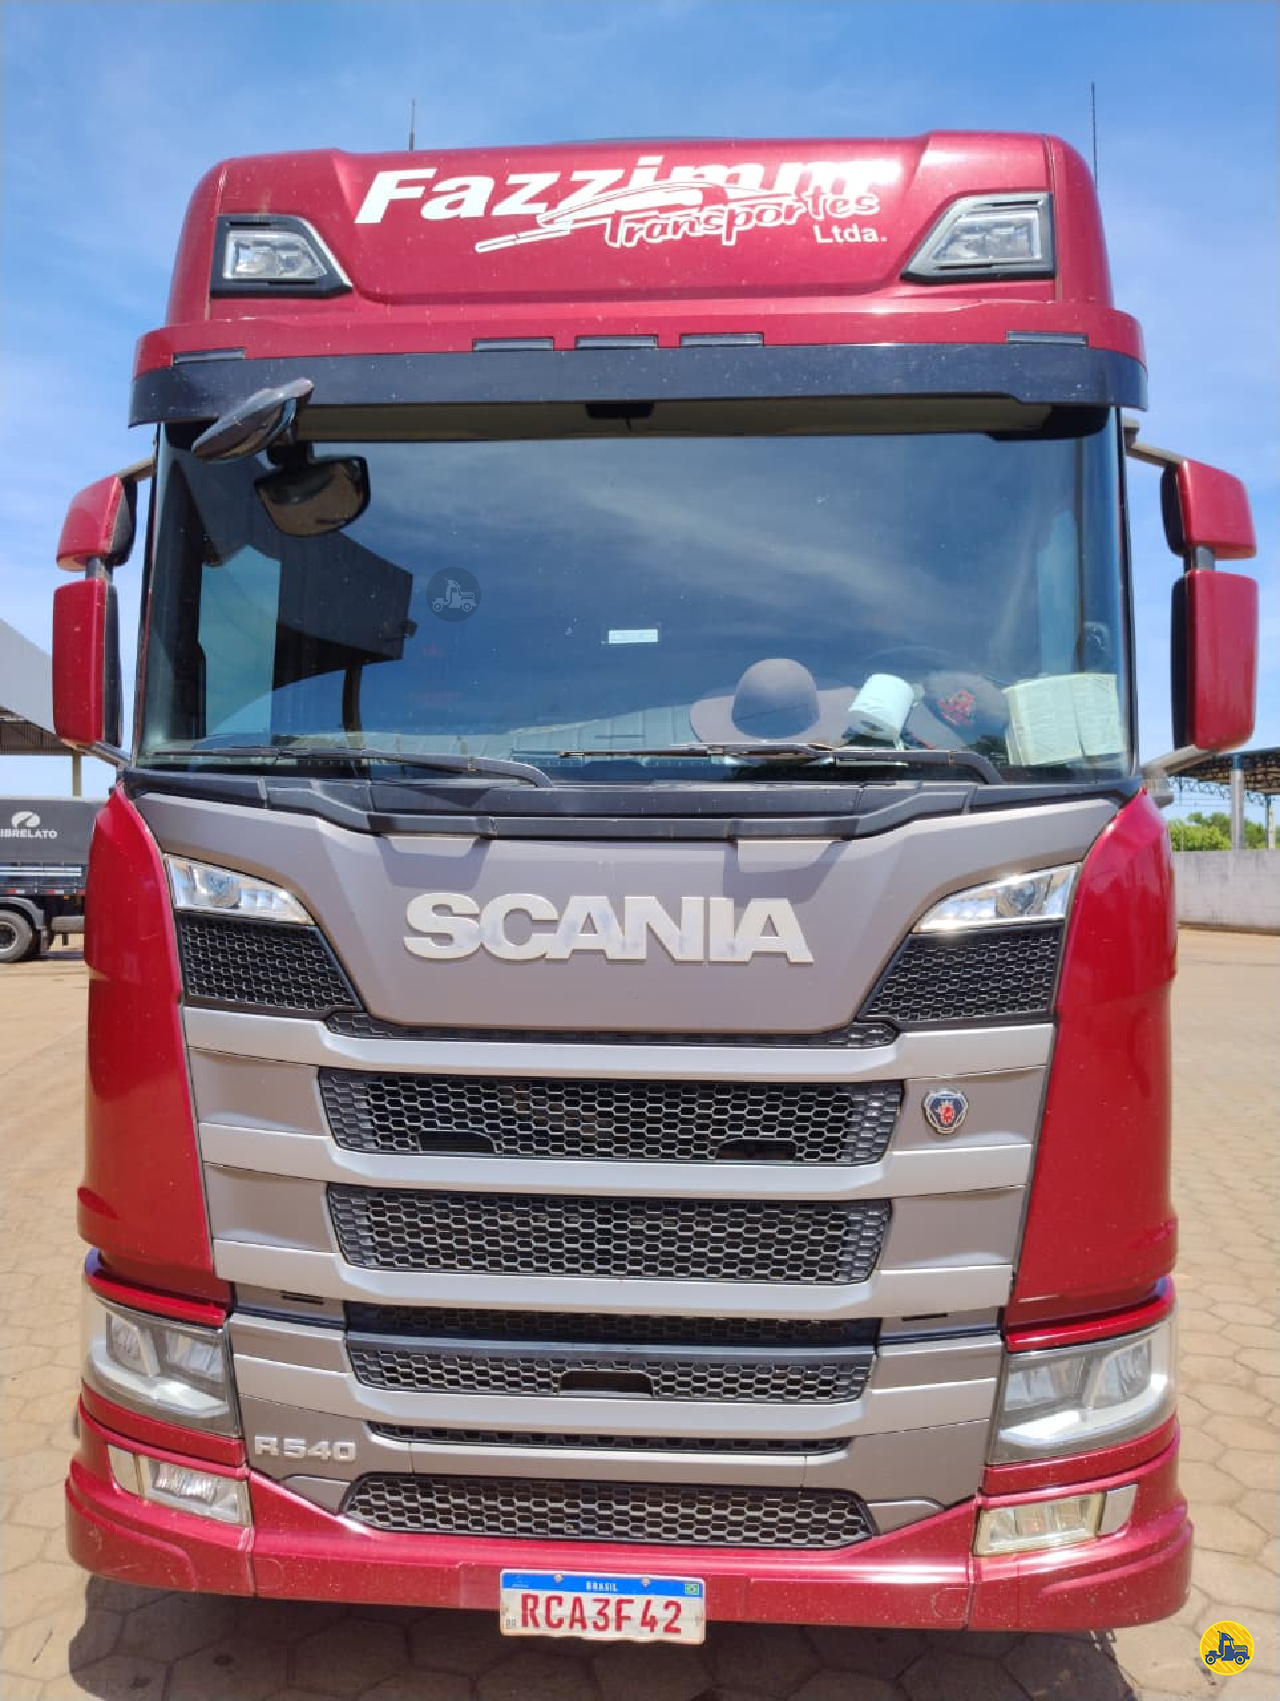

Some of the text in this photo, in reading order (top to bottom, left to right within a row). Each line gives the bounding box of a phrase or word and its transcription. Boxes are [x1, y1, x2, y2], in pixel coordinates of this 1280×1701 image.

[602, 190, 881, 247] Transportes
[812, 223, 887, 243] Ltda.
[0, 828, 58, 839] IBRELATO
[403, 892, 814, 963] SCANIA
[586, 1581, 618, 1592] BRASIL
[520, 1592, 682, 1634] RCA3F42
